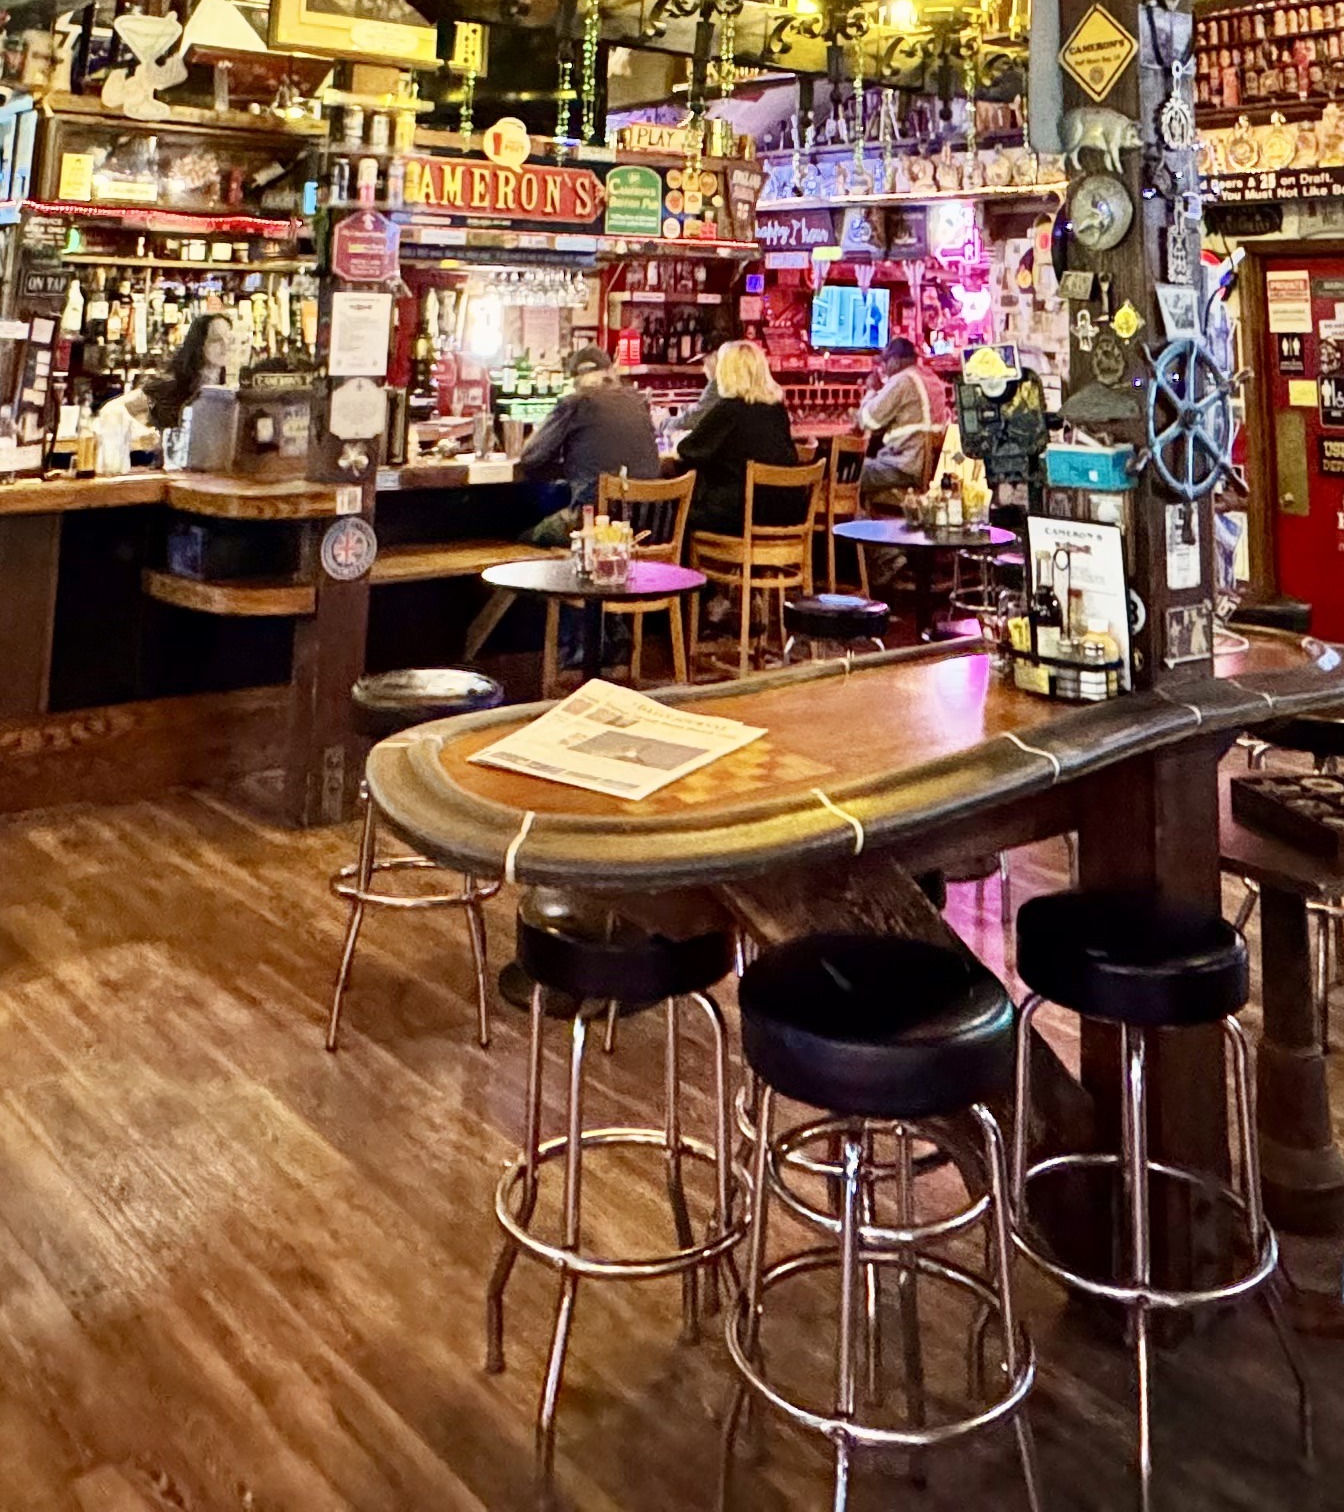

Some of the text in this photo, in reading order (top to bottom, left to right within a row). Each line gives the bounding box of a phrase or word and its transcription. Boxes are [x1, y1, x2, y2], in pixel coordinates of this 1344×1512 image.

[638, 127, 676, 148] PLAY
[1221, 190, 1242, 201] You
[1244, 188, 1273, 200] Must
[1277, 187, 1299, 199] Not
[1302, 185, 1328, 198] Like
[28, 276, 67, 292] ON TAP
